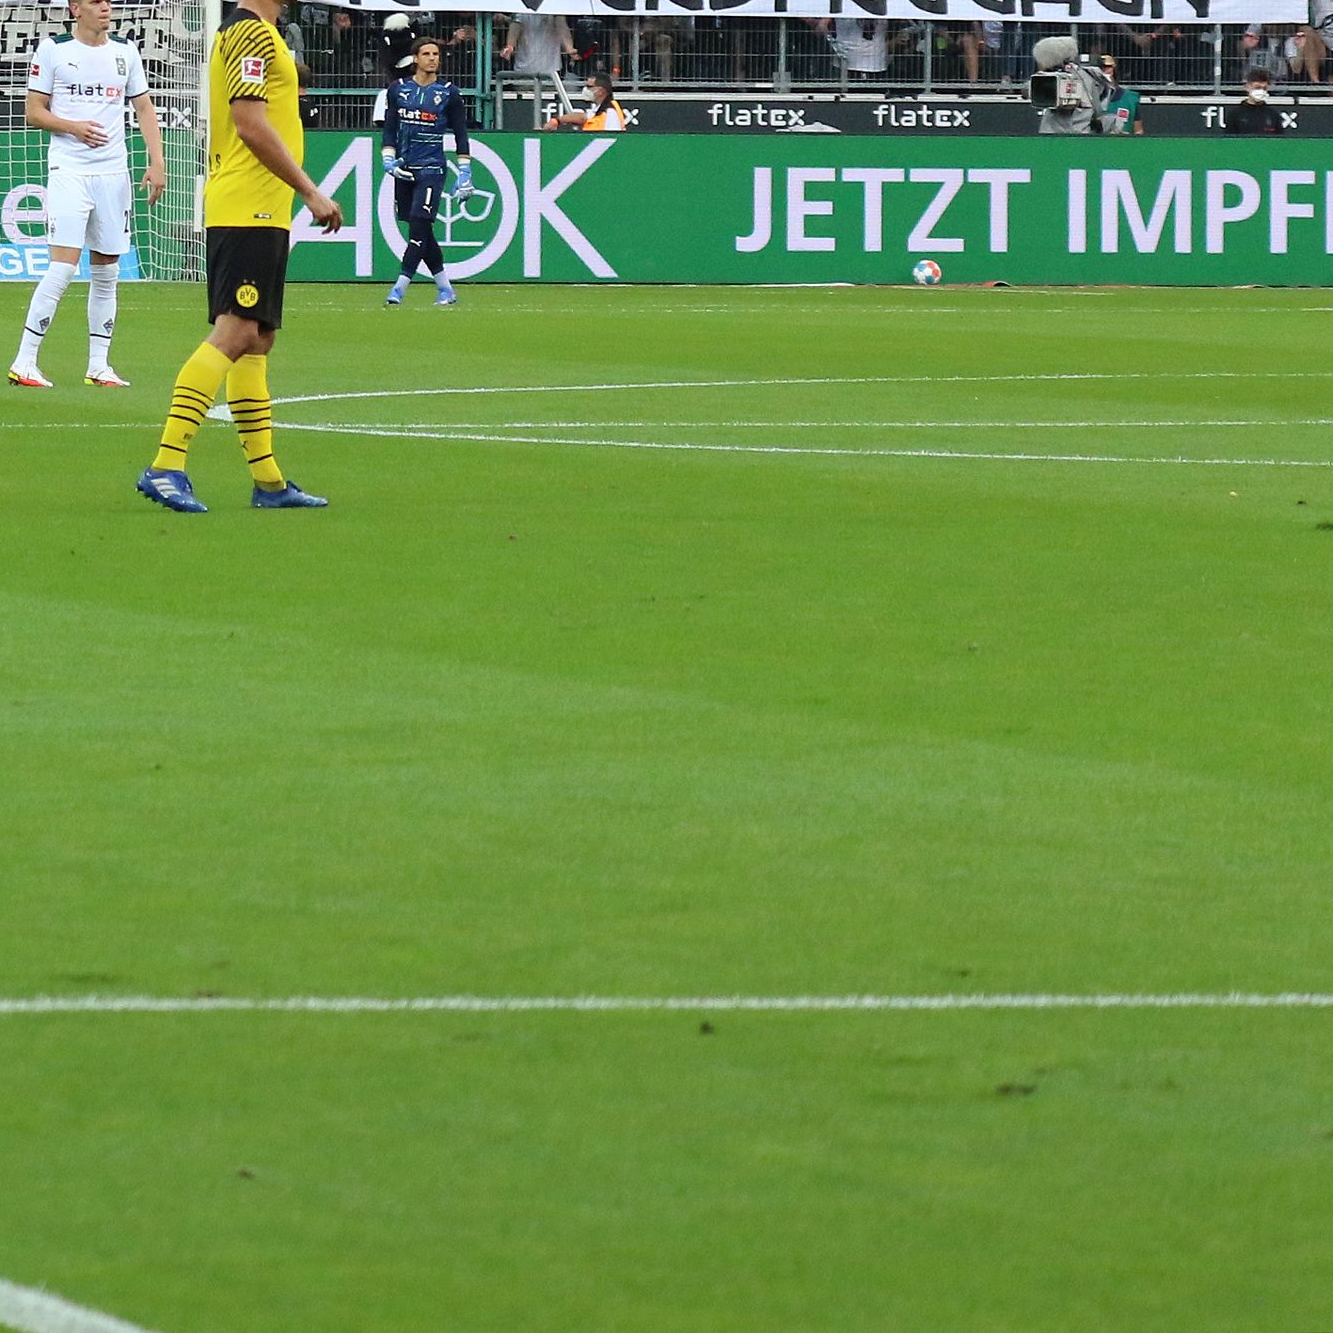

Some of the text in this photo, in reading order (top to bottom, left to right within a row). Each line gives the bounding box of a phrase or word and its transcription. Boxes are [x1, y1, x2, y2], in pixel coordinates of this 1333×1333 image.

[66, 82, 124, 98] flatex
[397, 107, 438, 121] flatex
[707, 103, 805, 127] flatex
[873, 104, 970, 128] flatex
[287, 136, 618, 280] AOK
[735, 168, 1333, 254] JETZT IMPF
